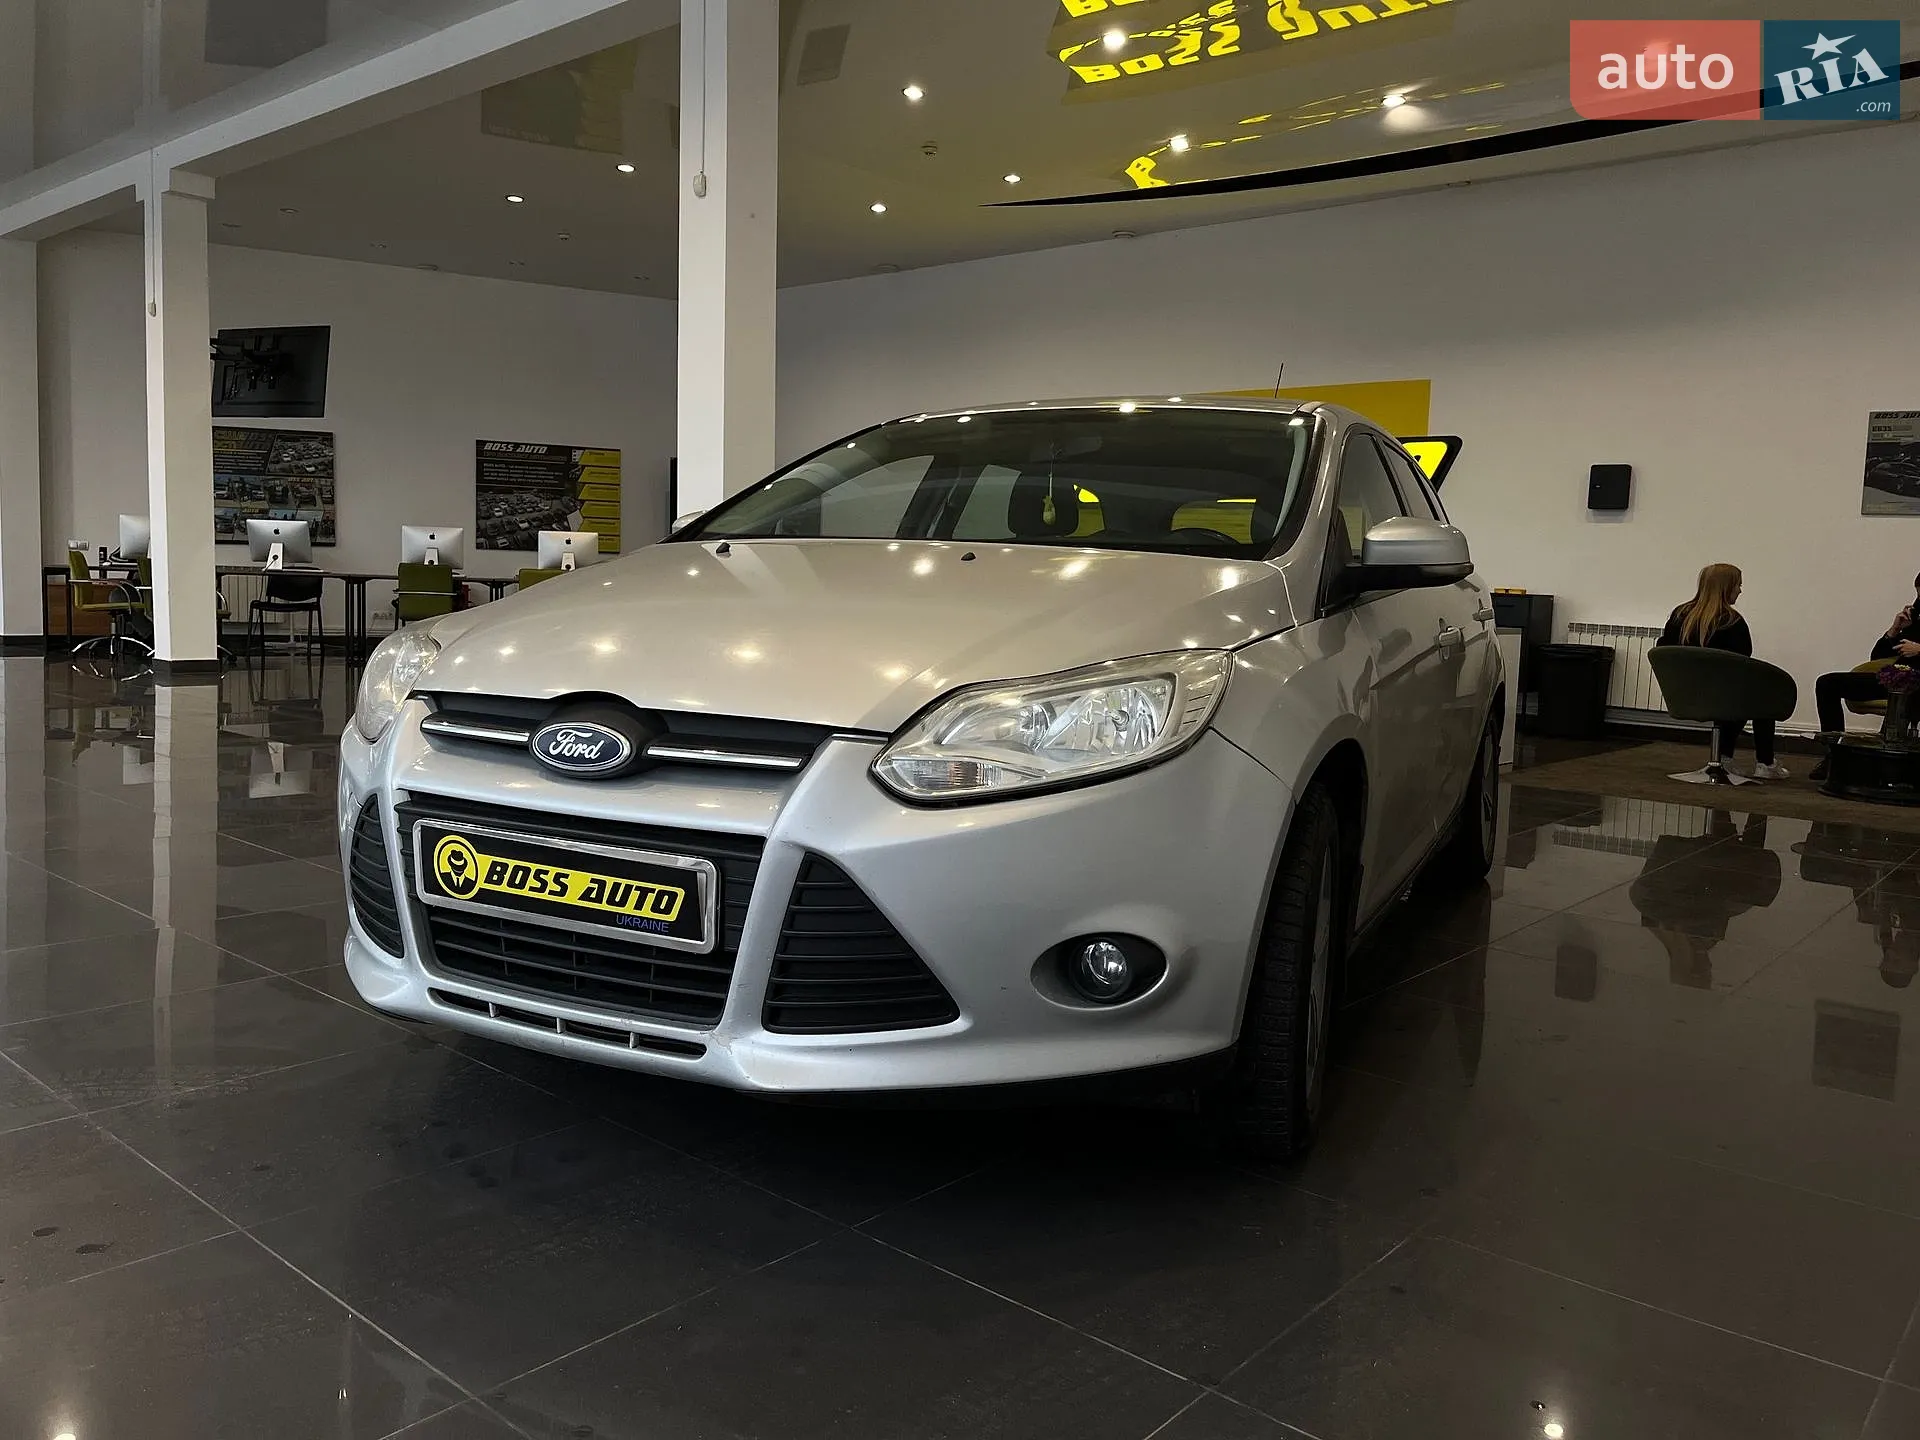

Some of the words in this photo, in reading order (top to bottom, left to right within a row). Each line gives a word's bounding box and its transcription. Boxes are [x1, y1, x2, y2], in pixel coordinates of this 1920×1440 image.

[484, 442, 514, 452] BOSS
[516, 445, 548, 454] AUTO
[548, 727, 605, 761] Ford
[483, 860, 571, 897] BOSS
[577, 877, 679, 915] AUTO
[616, 914, 670, 933] UKRAINE
